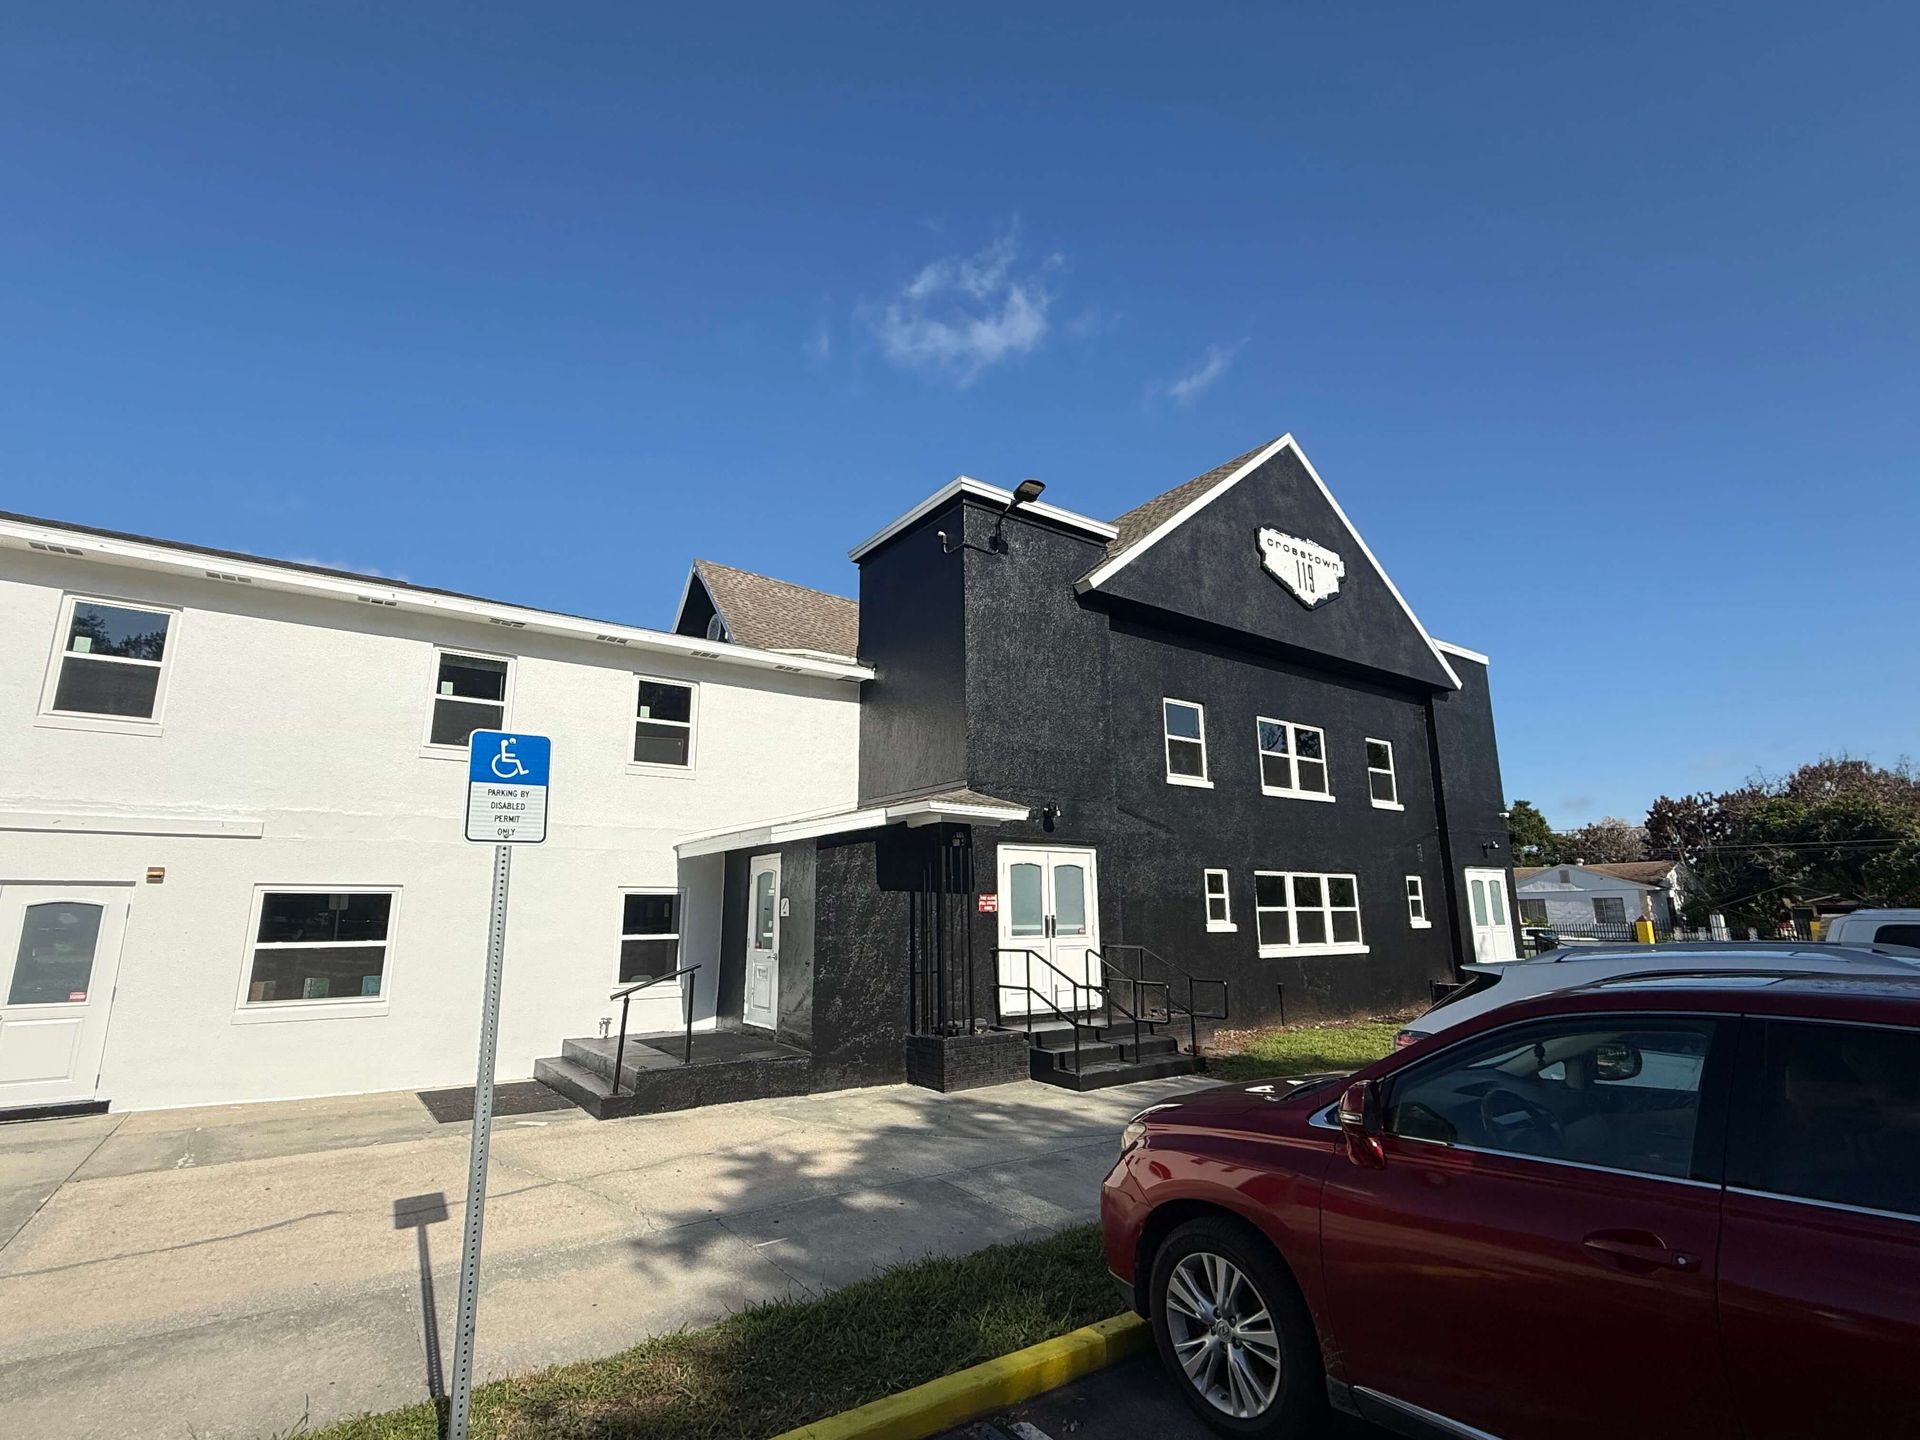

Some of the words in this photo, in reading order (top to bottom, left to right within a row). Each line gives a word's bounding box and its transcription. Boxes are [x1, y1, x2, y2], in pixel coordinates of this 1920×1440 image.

[1266, 538, 1339, 571] crosstown
[1295, 559, 1315, 593] 119
[487, 788, 518, 798] PARKING
[520, 790, 530, 798] BY
[490, 801, 526, 811] DISABLED
[494, 814, 521, 823] PERMIT
[497, 827, 516, 836] ONLY
